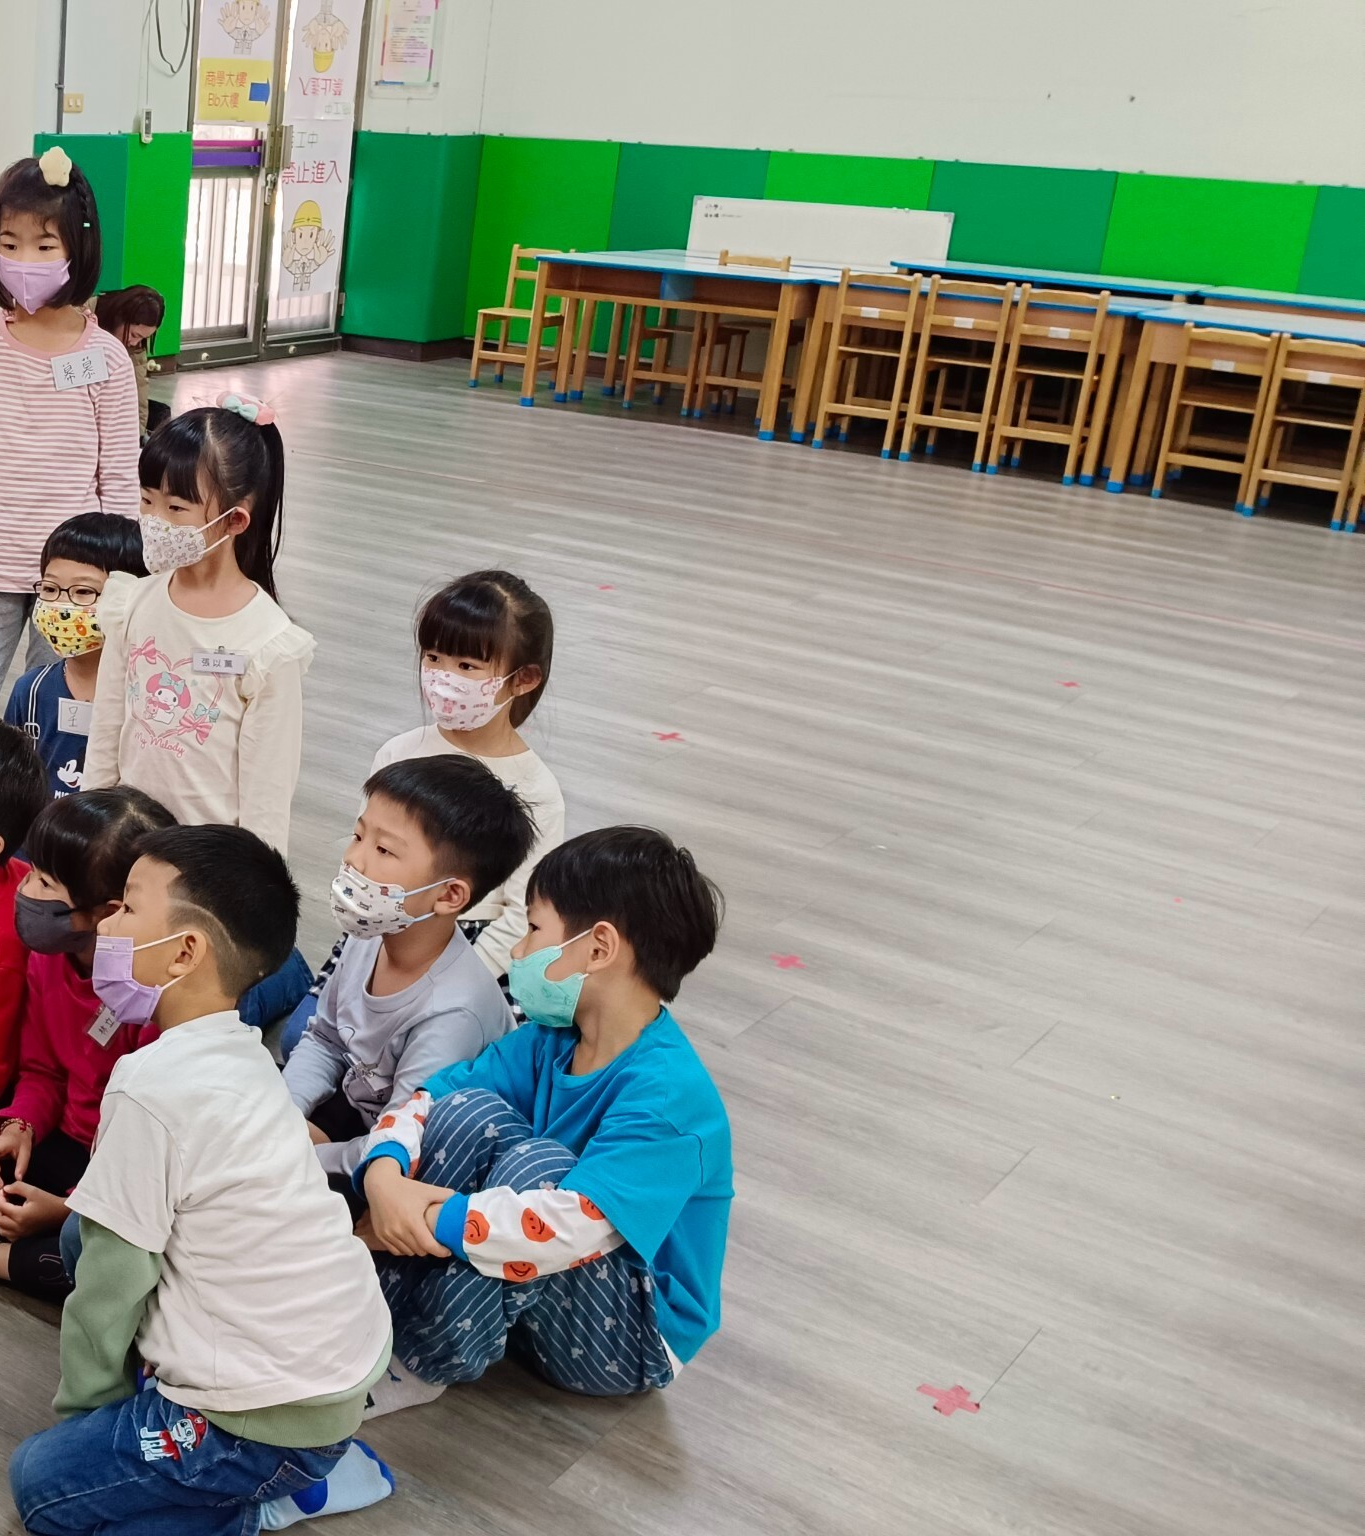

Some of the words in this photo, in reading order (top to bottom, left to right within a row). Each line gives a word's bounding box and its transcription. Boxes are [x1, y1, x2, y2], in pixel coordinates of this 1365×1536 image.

[282, 160, 342, 184] 禁止進入
[135, 732, 147, 749] My
[150, 735, 185, 758] Melody
